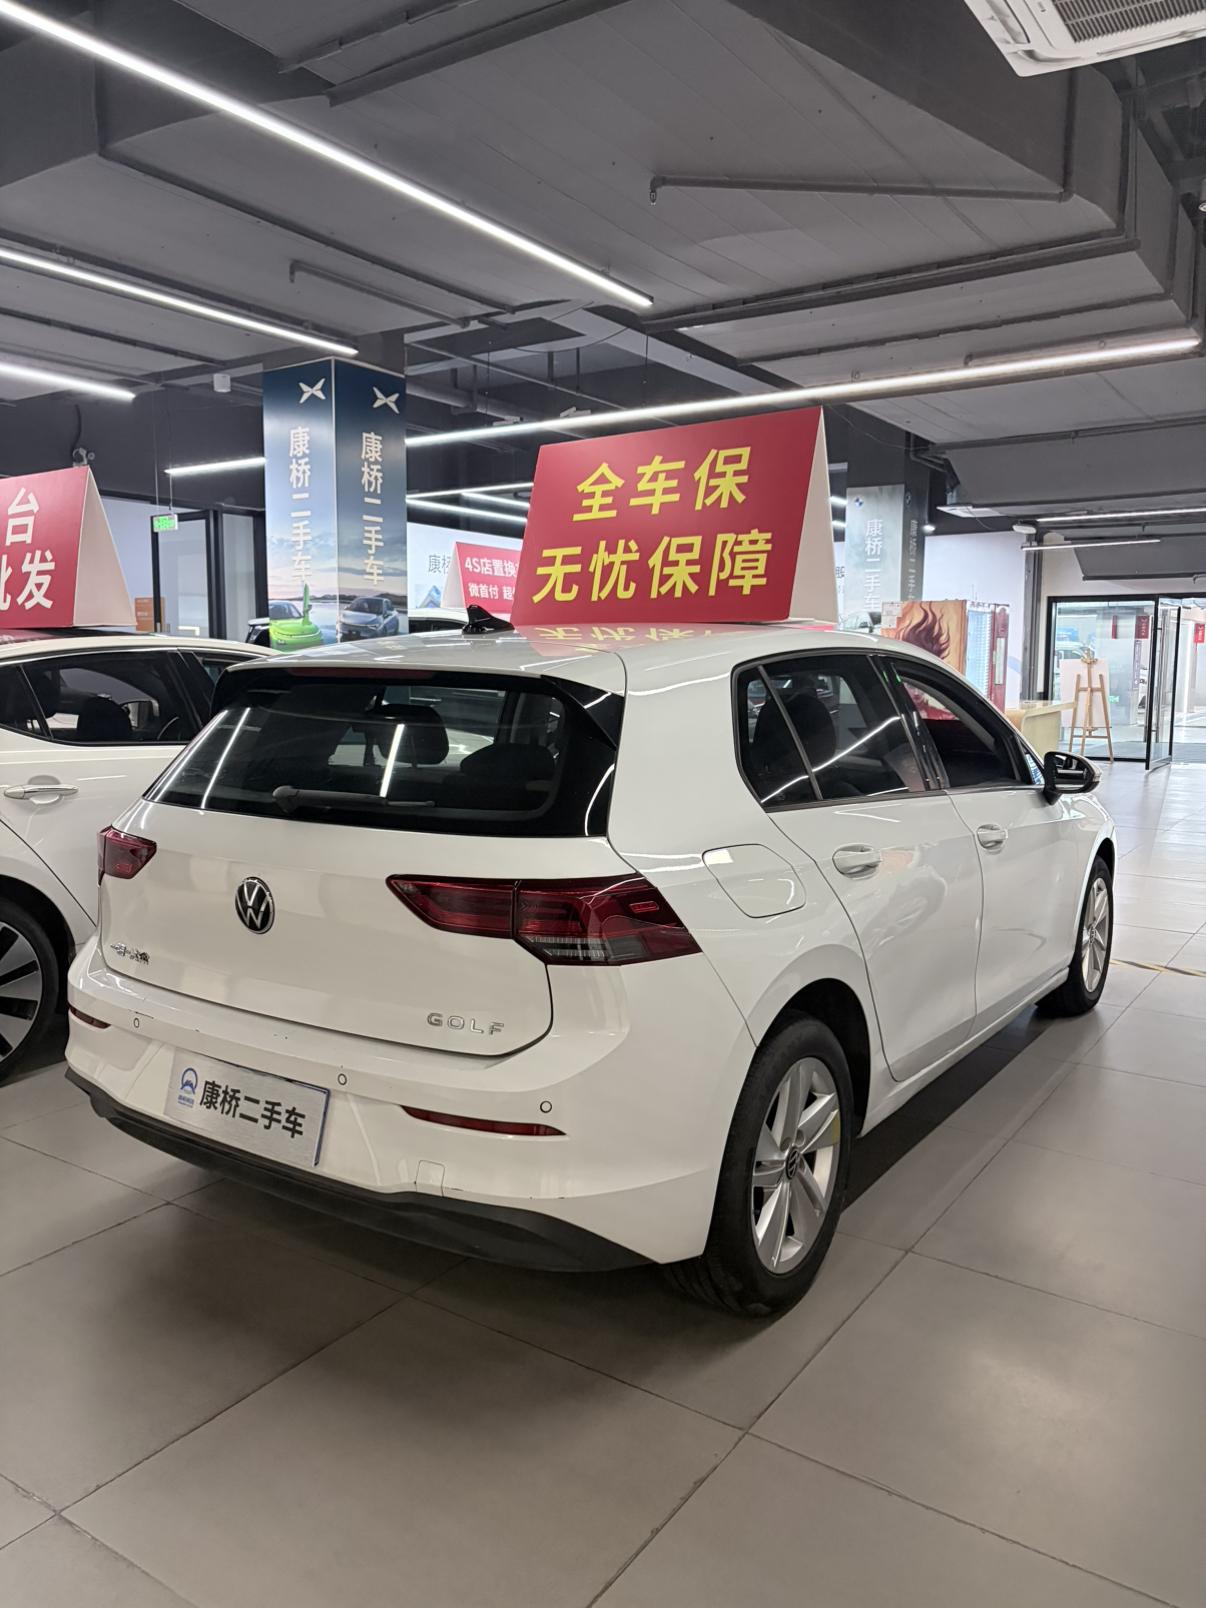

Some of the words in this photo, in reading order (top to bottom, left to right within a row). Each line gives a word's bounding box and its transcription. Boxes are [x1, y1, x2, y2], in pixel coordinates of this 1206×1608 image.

[5, 487, 39, 546] 台
[288, 426, 312, 582] 康桥二手车
[360, 431, 385, 586] 康桥二手车
[572, 446, 751, 522] 全车保
[465, 557, 519, 577] 4S店置换
[532, 528, 772, 604] 无忧保障
[427, 1012, 505, 1035] GOLF
[200, 1080, 306, 1139] 康桥二手车
